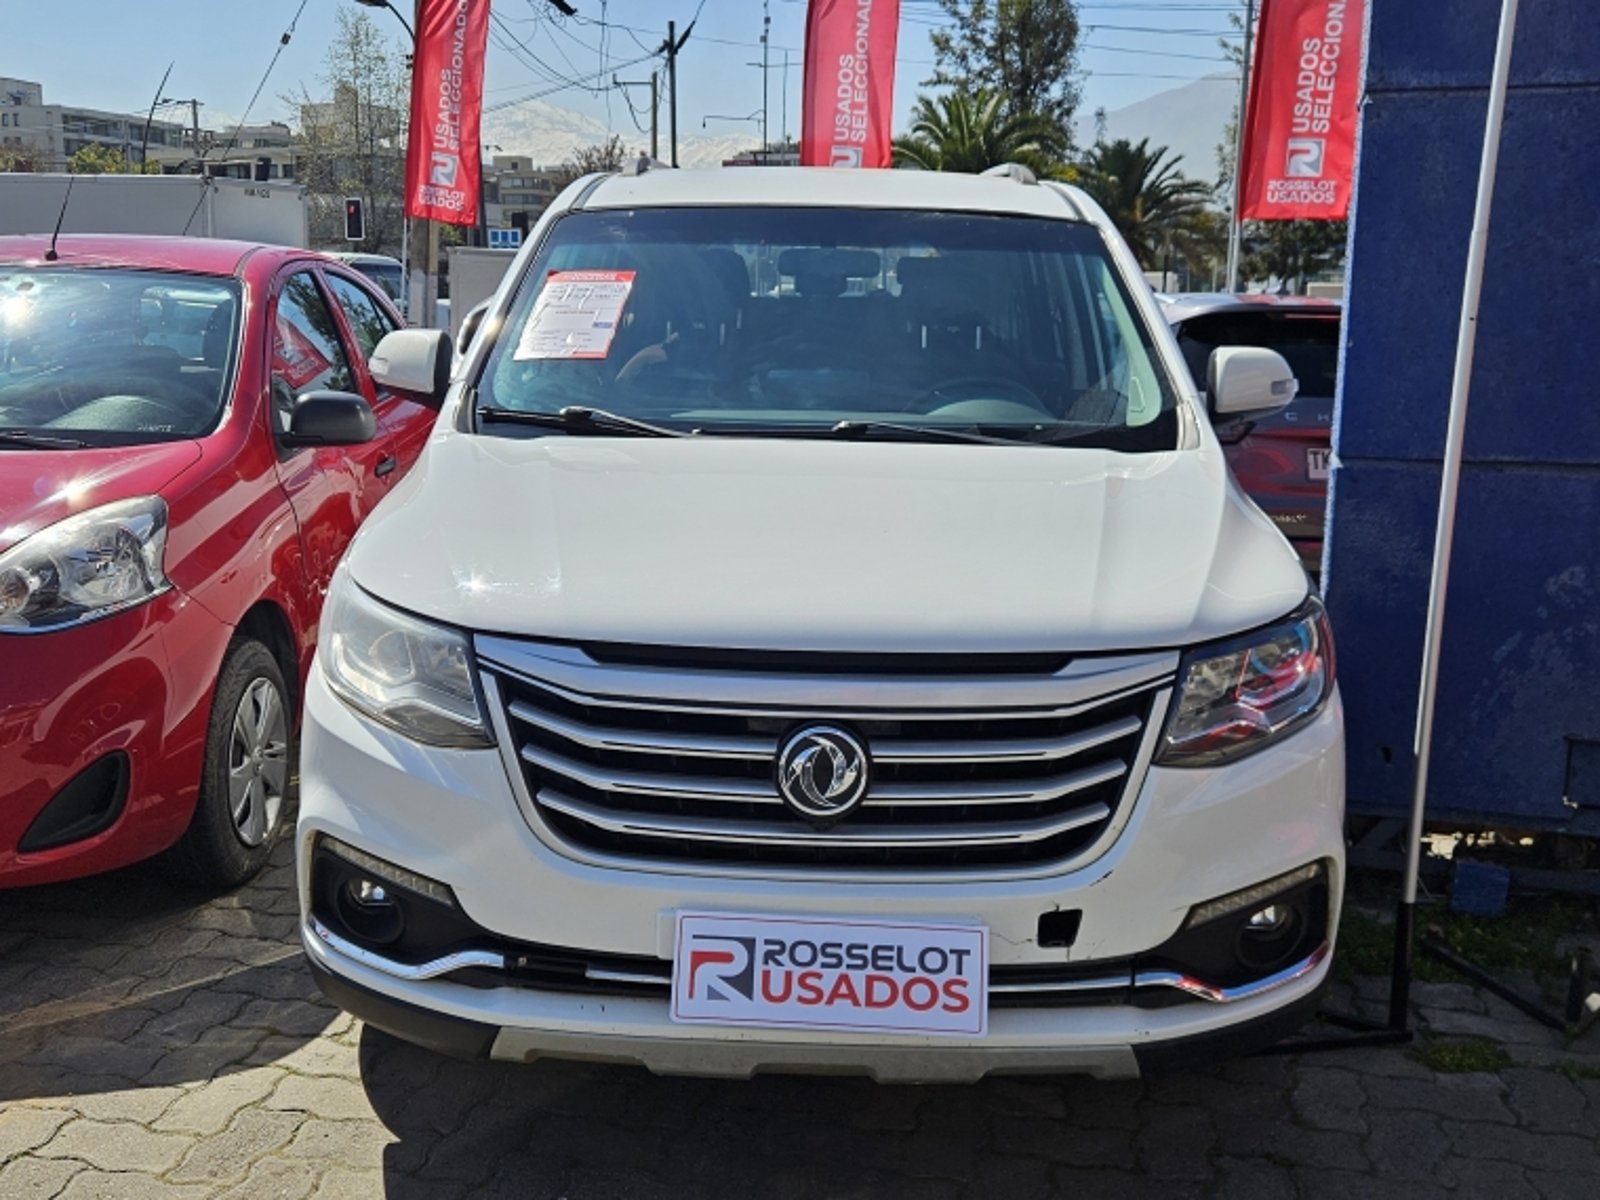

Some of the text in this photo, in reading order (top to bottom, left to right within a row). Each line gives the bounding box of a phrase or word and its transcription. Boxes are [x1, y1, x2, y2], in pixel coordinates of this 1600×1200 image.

[834, 54, 854, 141] USADOS
[1292, 37, 1321, 133] USADOS
[1312, 0, 1346, 133] SELECCION
[433, 68, 452, 149] USADOS
[1266, 190, 1336, 204] USADOS
[1267, 179, 1337, 192] ROSSELOT
[763, 937, 971, 976] ROSSELOT
[761, 969, 970, 1014] USADOS
